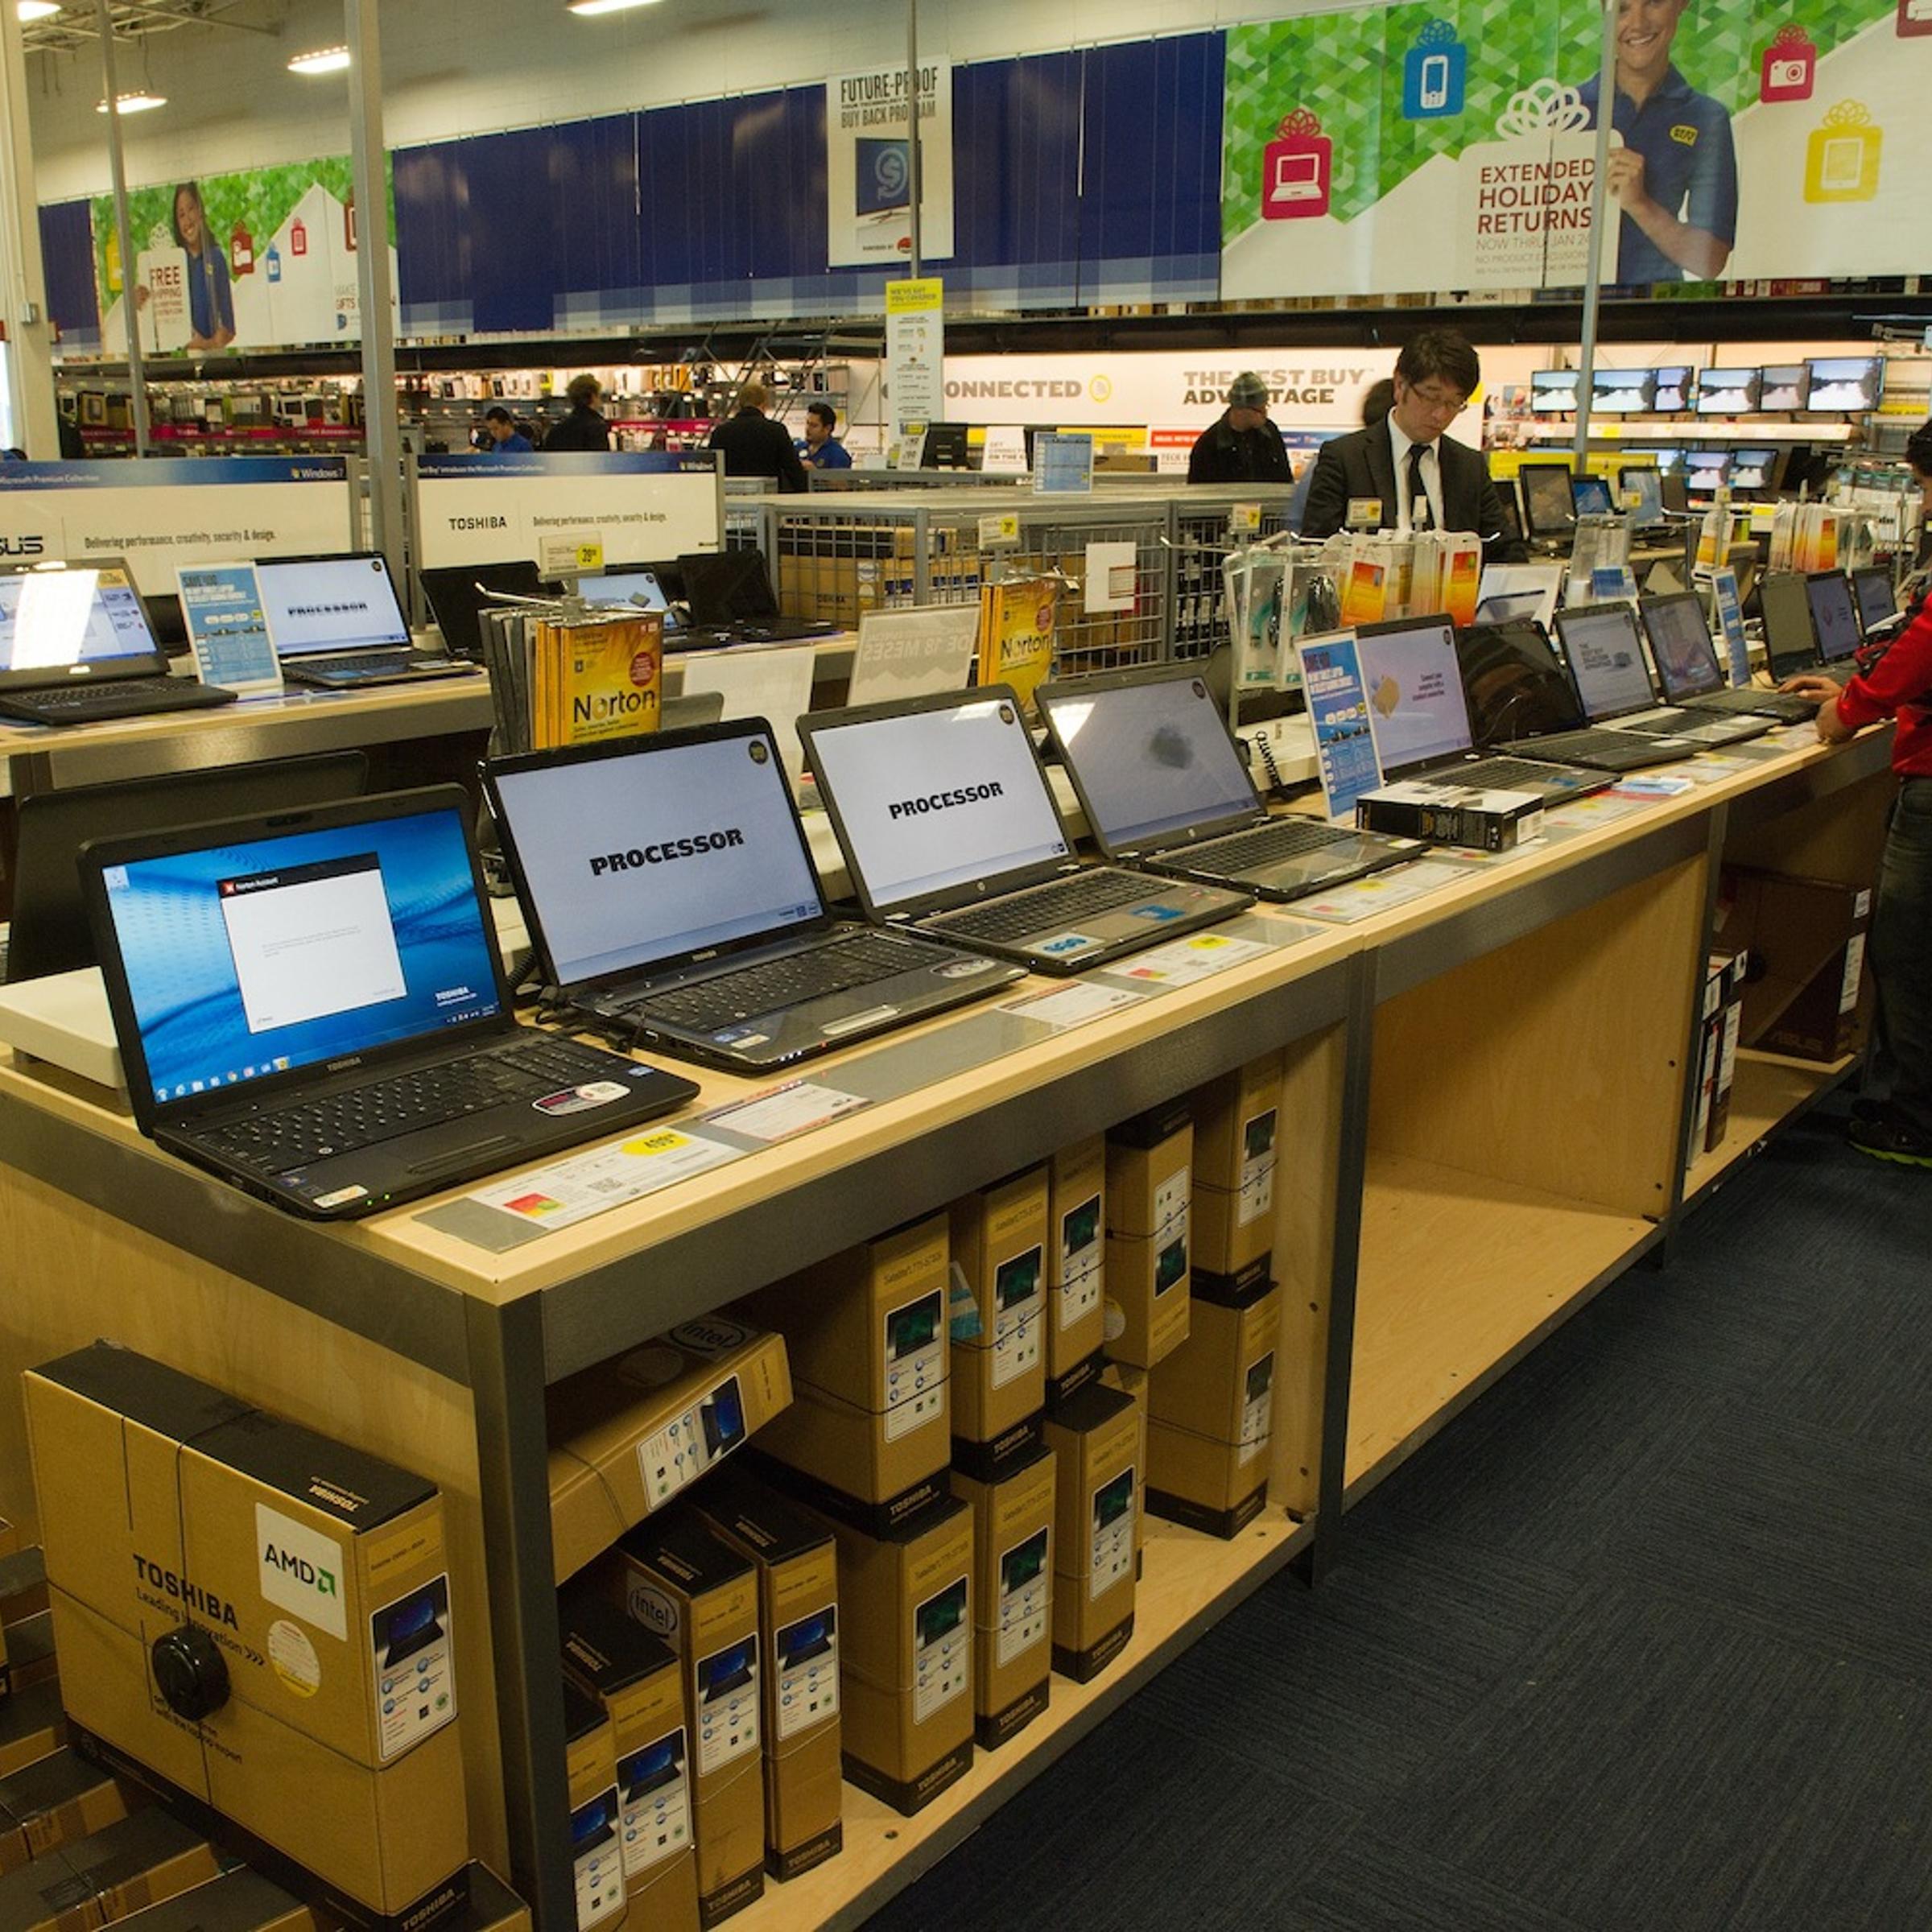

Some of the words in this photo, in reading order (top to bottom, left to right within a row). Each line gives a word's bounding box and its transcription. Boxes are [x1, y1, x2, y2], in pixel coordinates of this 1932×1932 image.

[841, 111, 860, 128] BUY
[862, 106, 887, 126] BACK
[890, 101, 935, 122] PROAM
[1480, 159, 1596, 184] EXTENDED
[1480, 180, 1595, 209] HOLIDAY
[1477, 207, 1592, 235] RETURNS
[1476, 238, 1509, 250] NOW
[149, 266, 180, 287] FREE
[1183, 371, 1232, 386] THE
[1311, 368, 1365, 385] BUY
[301, 468, 338, 479] Windows
[449, 516, 507, 530] TOSHIBA
[85, 538, 124, 550] Delivering
[213, 530, 242, 543] security
[244, 530, 250, 540] &
[288, 601, 368, 617] PROCESSOR
[1000, 634, 1050, 661] Norton
[574, 690, 655, 723] Norton
[889, 781, 1004, 820] PROCESSOR
[589, 828, 745, 877] PROCESSOR
[309, 1484, 359, 1513] TOSHIBA
[890, 1484, 931, 1515] TOSHIBA
[264, 1542, 316, 1584] AMD
[133, 1553, 239, 1631] TOSHIBA
[137, 1587, 180, 1623] Leading
[403, 1888, 456, 1931] TOSHIBA
